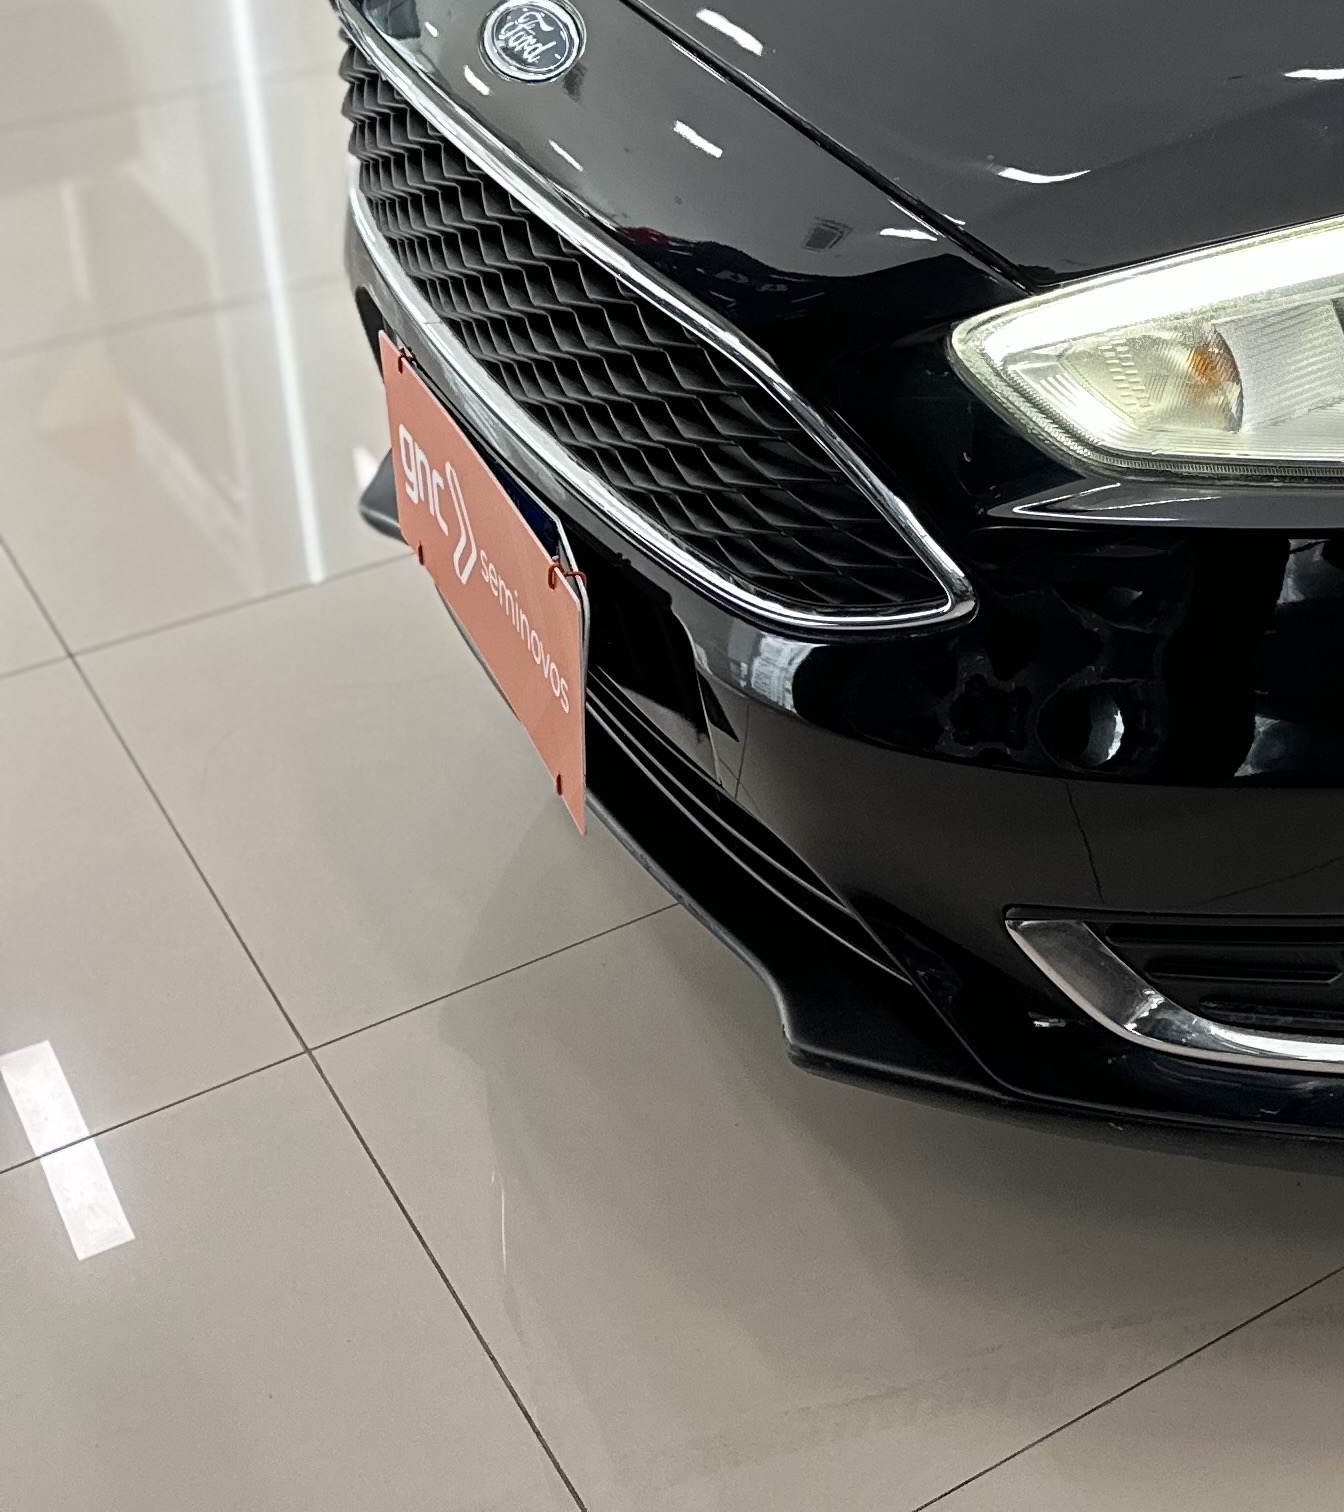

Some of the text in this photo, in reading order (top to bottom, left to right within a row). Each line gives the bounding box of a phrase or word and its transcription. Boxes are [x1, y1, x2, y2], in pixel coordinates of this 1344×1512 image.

[498, 11, 556, 63] Ford
[399, 423, 570, 714] gnc seminovos
